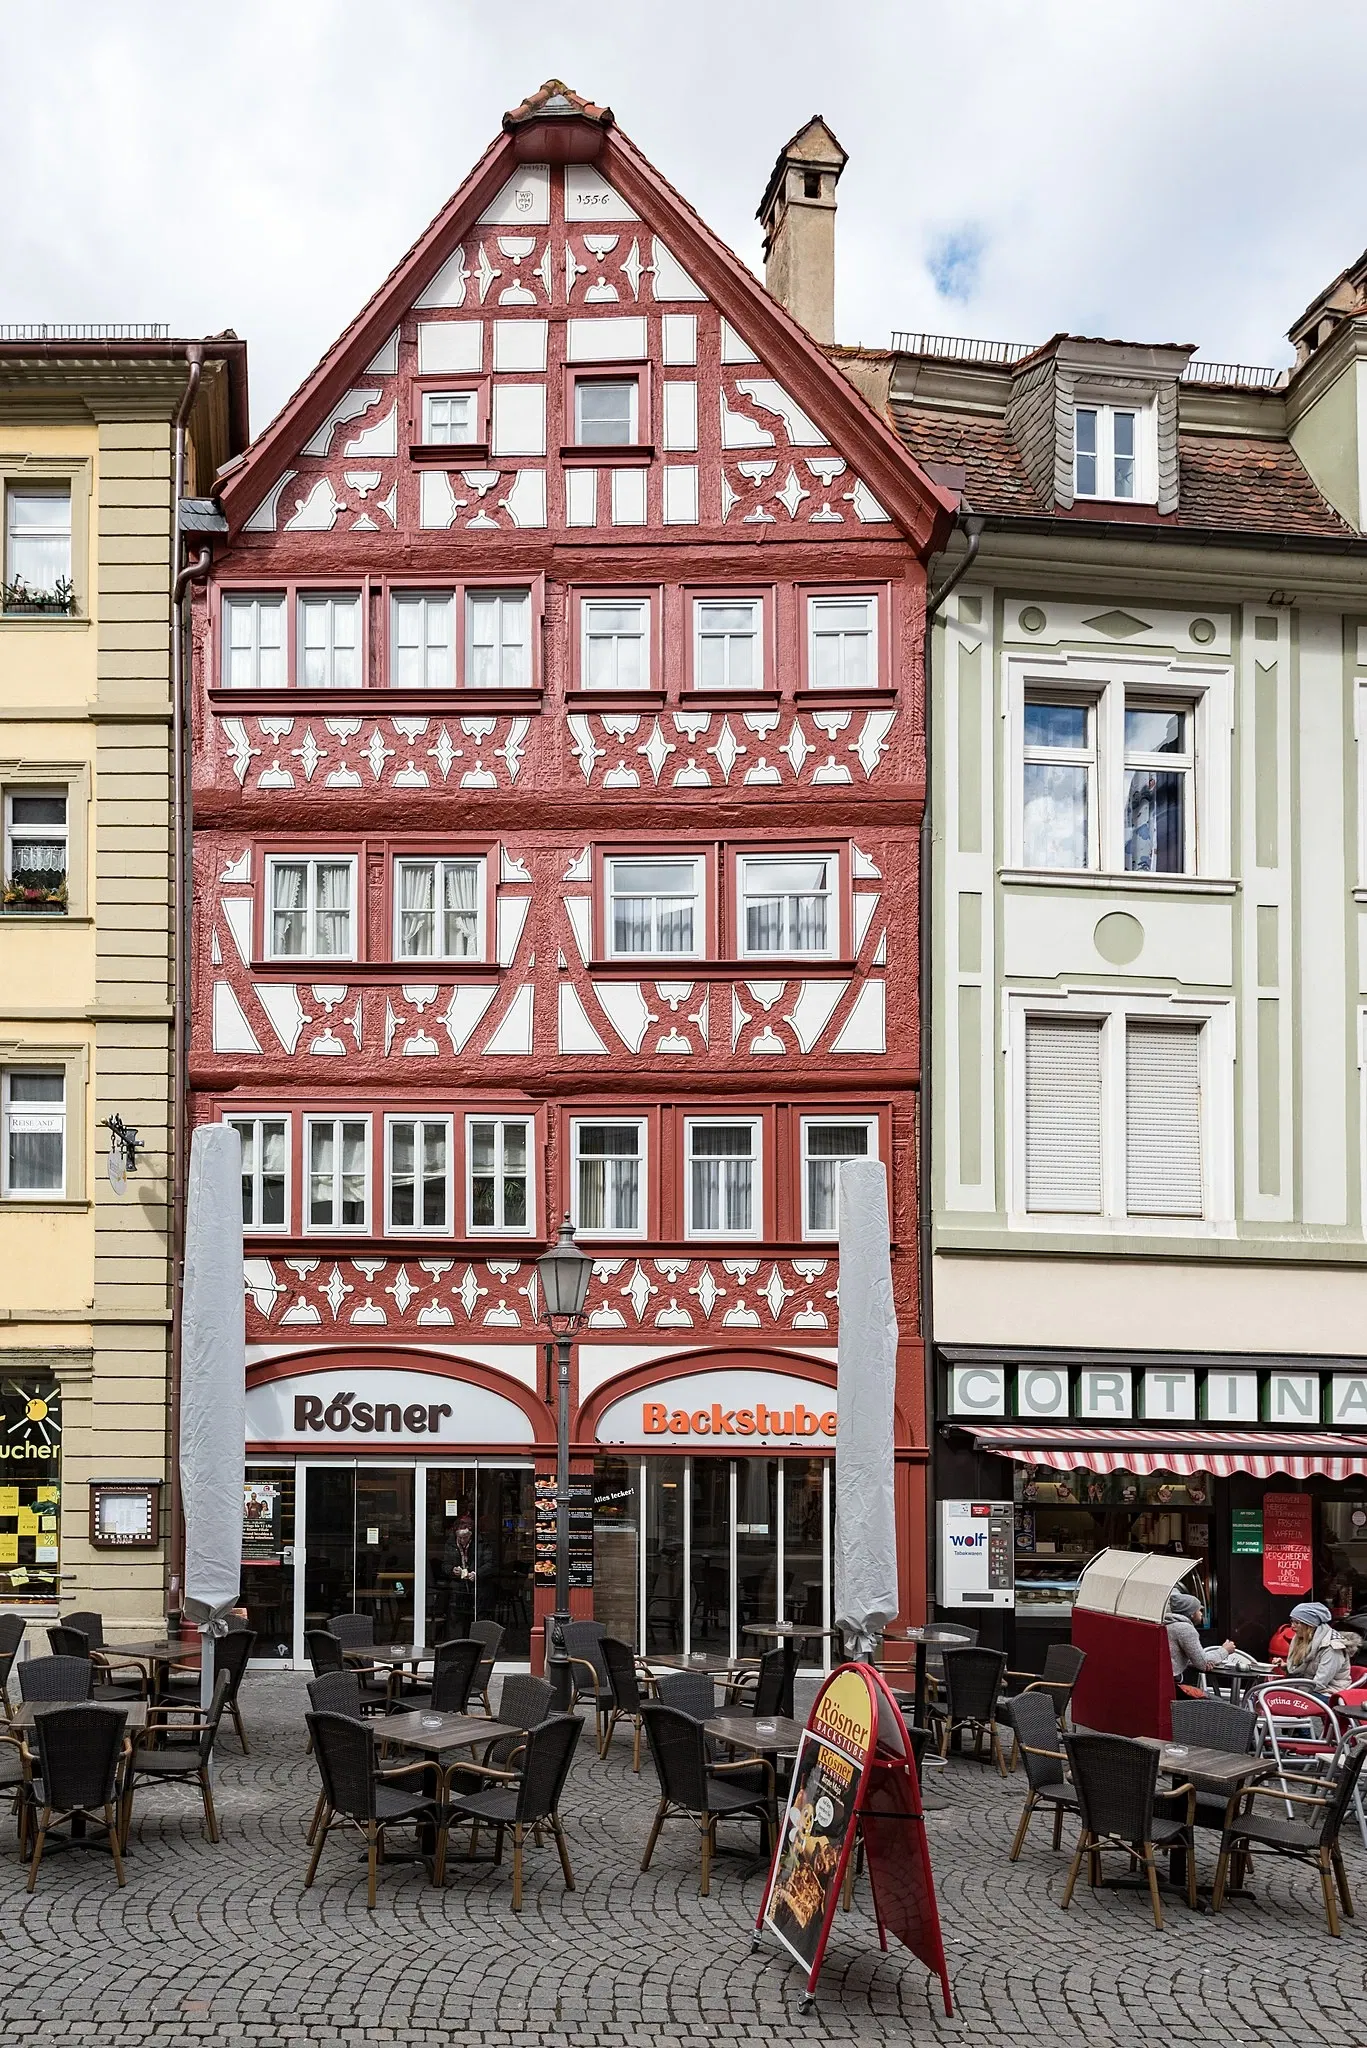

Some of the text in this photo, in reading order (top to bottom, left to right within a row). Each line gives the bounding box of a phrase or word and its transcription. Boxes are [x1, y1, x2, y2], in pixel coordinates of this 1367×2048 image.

[561, 1366, 568, 1375] 8
[958, 1368, 1367, 1417] CORTINA
[643, 1403, 837, 1436] Backstube
[593, 1487, 635, 1504] Alles lecker!
[949, 1533, 987, 1546] wolf
[1265, 1552, 1309, 1561] VERSCHIEDENE
[1266, 1696, 1309, 1710] Cortina Eis
[820, 1696, 868, 1744] Rösner
[816, 1720, 864, 1760] BACKSTUBE
[819, 1762, 848, 1788] BACKSTUBE
[820, 1748, 851, 1777] Rösner
